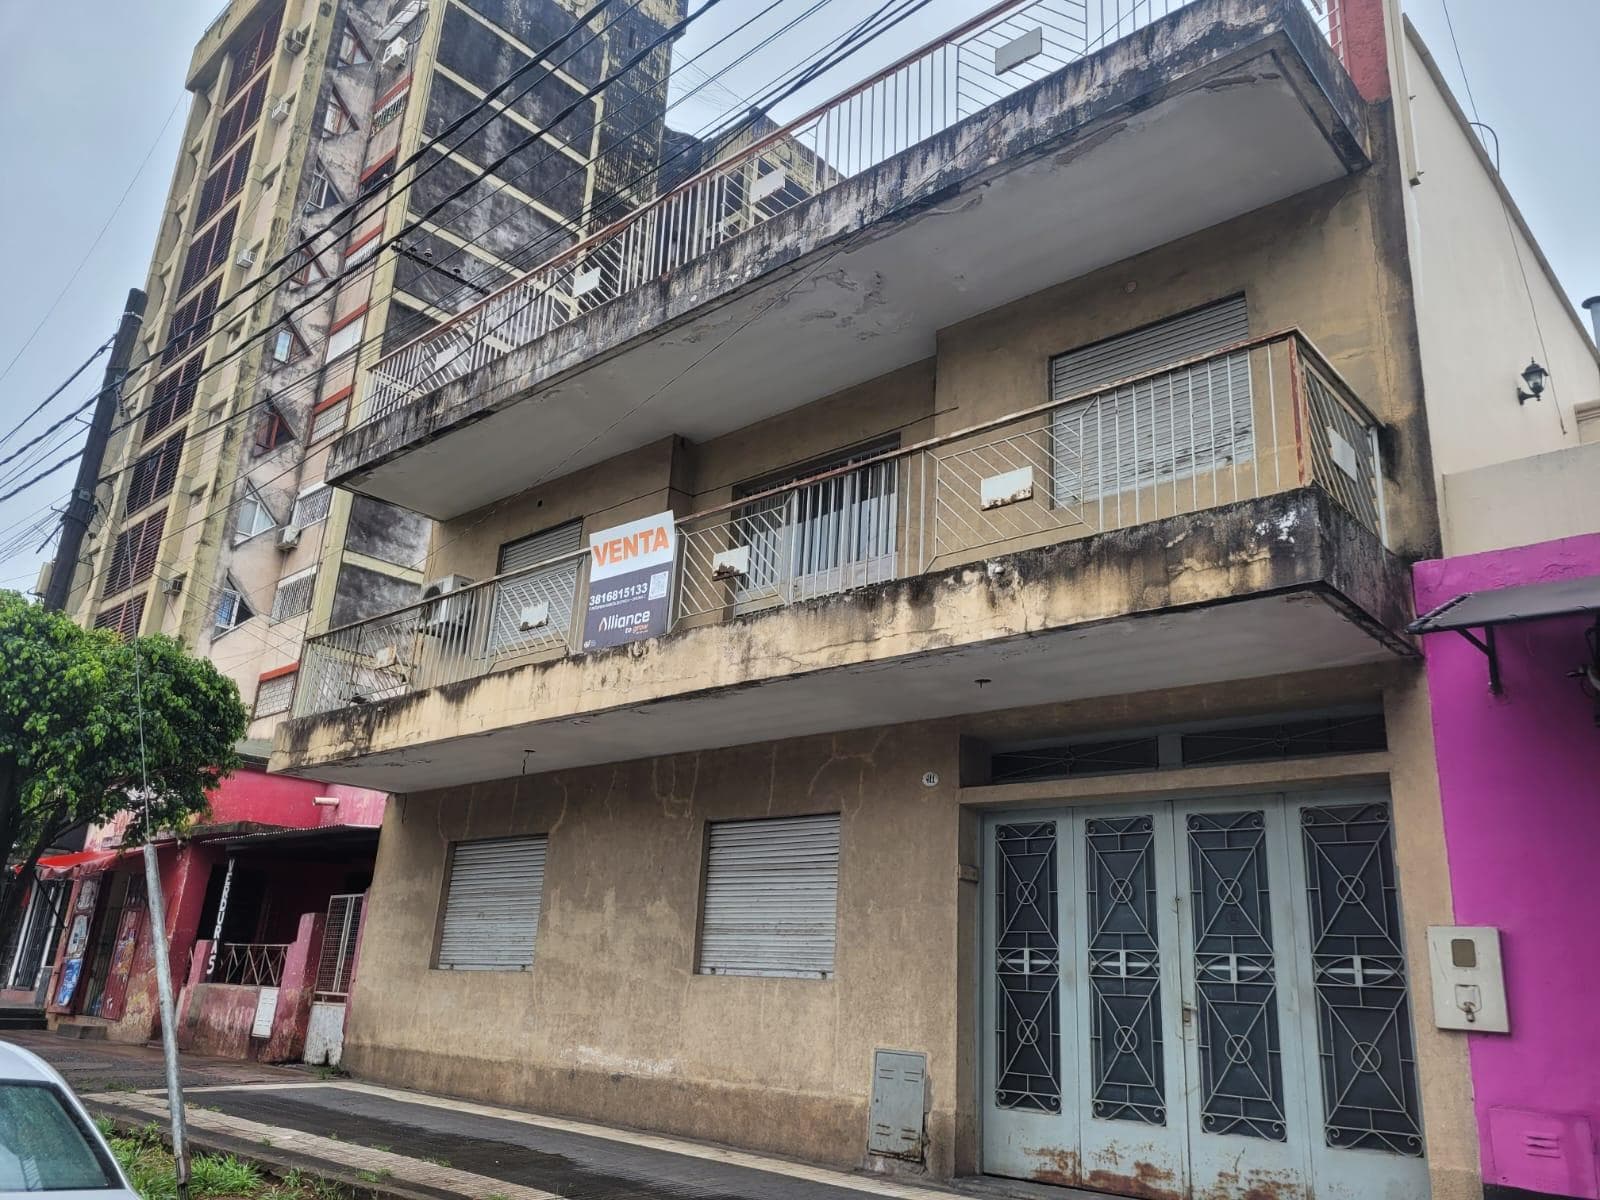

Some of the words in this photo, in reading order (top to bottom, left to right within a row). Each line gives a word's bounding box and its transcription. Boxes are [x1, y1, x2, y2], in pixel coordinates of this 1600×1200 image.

[593, 527, 669, 566] VENTA
[588, 582, 648, 606] 3816815133
[598, 611, 650, 632] Alliance
[206, 858, 235, 975] VERDURAS
